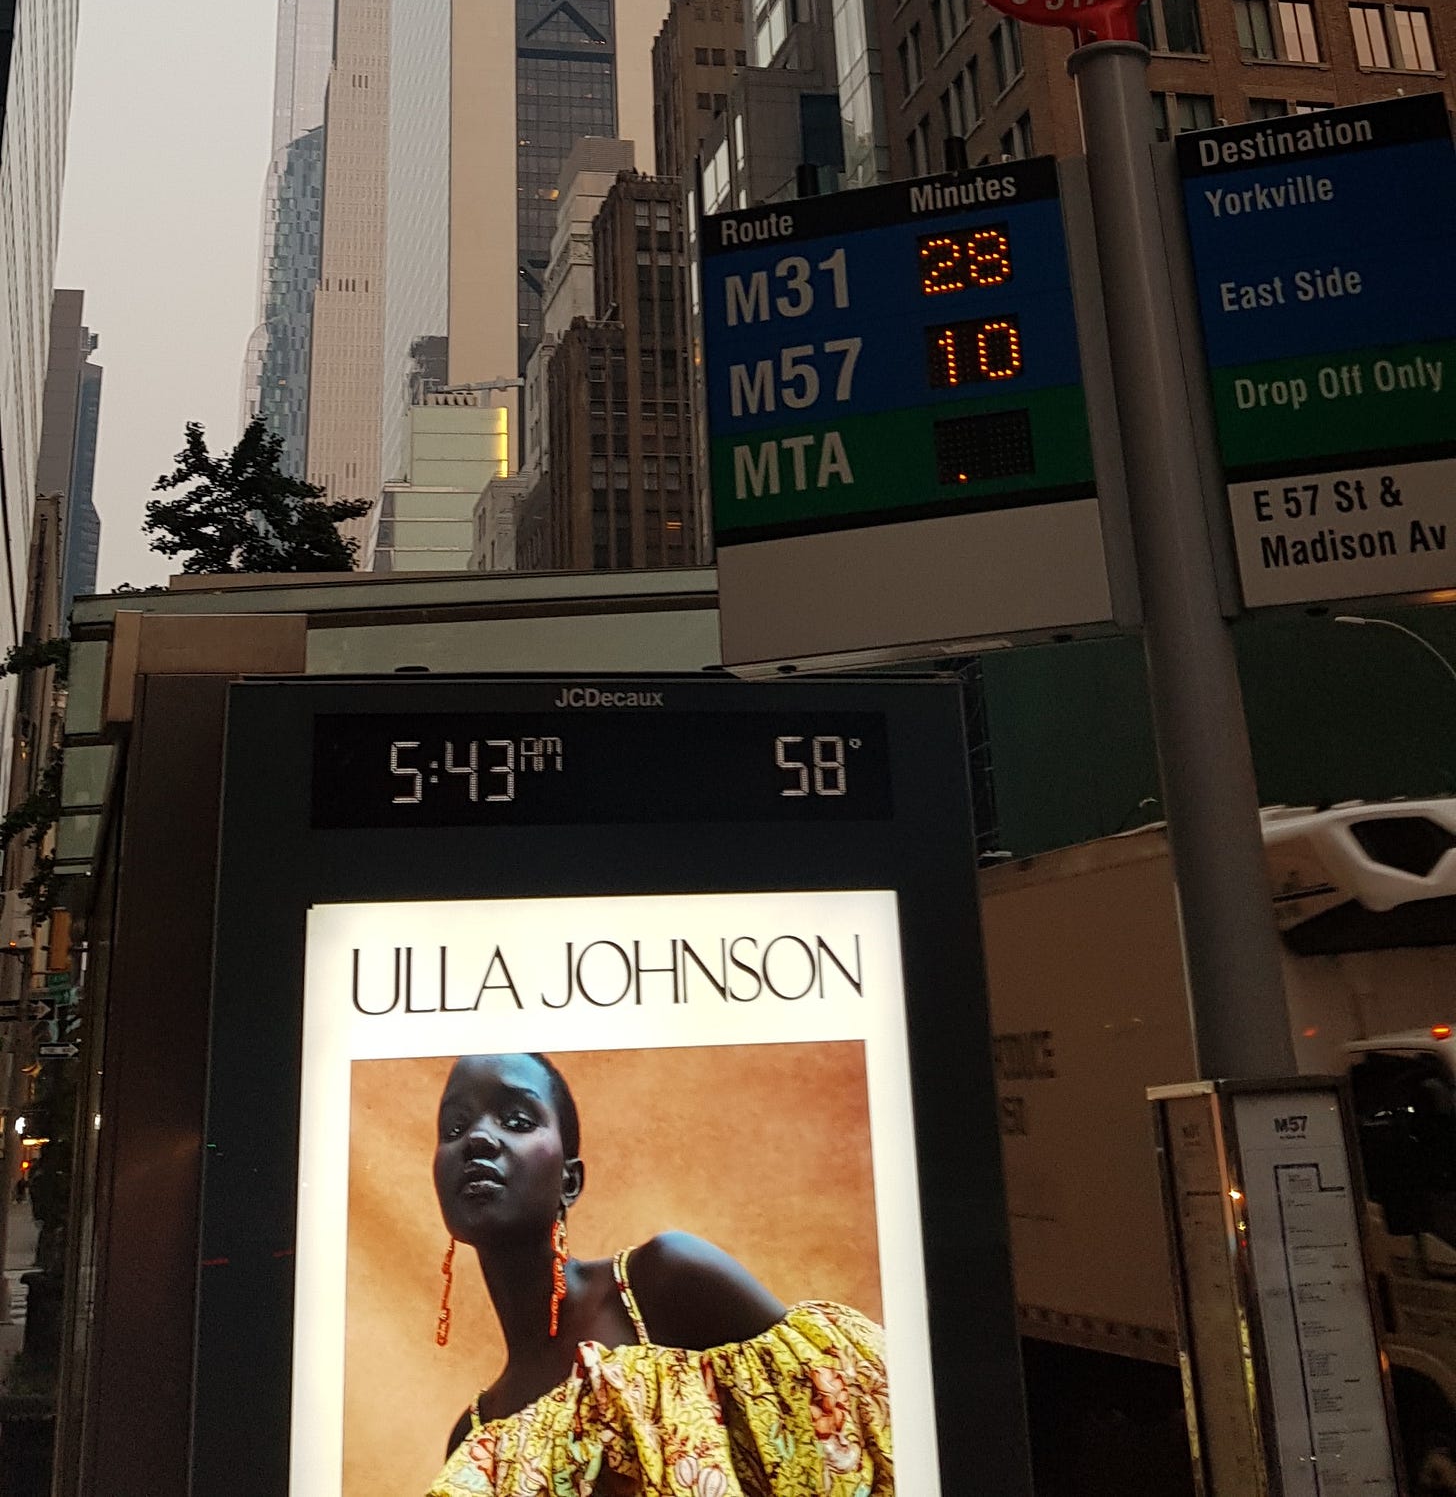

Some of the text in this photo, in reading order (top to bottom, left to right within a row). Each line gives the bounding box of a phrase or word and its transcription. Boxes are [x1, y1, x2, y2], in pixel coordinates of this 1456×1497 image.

[1199, 118, 1374, 168] Destination
[720, 175, 1017, 246] Route Minutes
[1204, 174, 1334, 218] Yorkville
[725, 247, 850, 327] M31
[921, 230, 1011, 295] 28
[1220, 266, 1362, 312] East Side
[729, 337, 863, 417] M57
[938, 321, 1021, 386] 10
[1234, 355, 1444, 410] Drop Off Only
[733, 430, 854, 500] MTA
[1253, 475, 1404, 523] E 57 St &
[1260, 519, 1448, 570] Madison Av
[554, 687, 664, 708] JCDecaux
[351, 933, 864, 1017] ULLA JOHNSON
[1274, 1114, 1309, 1134] M57
